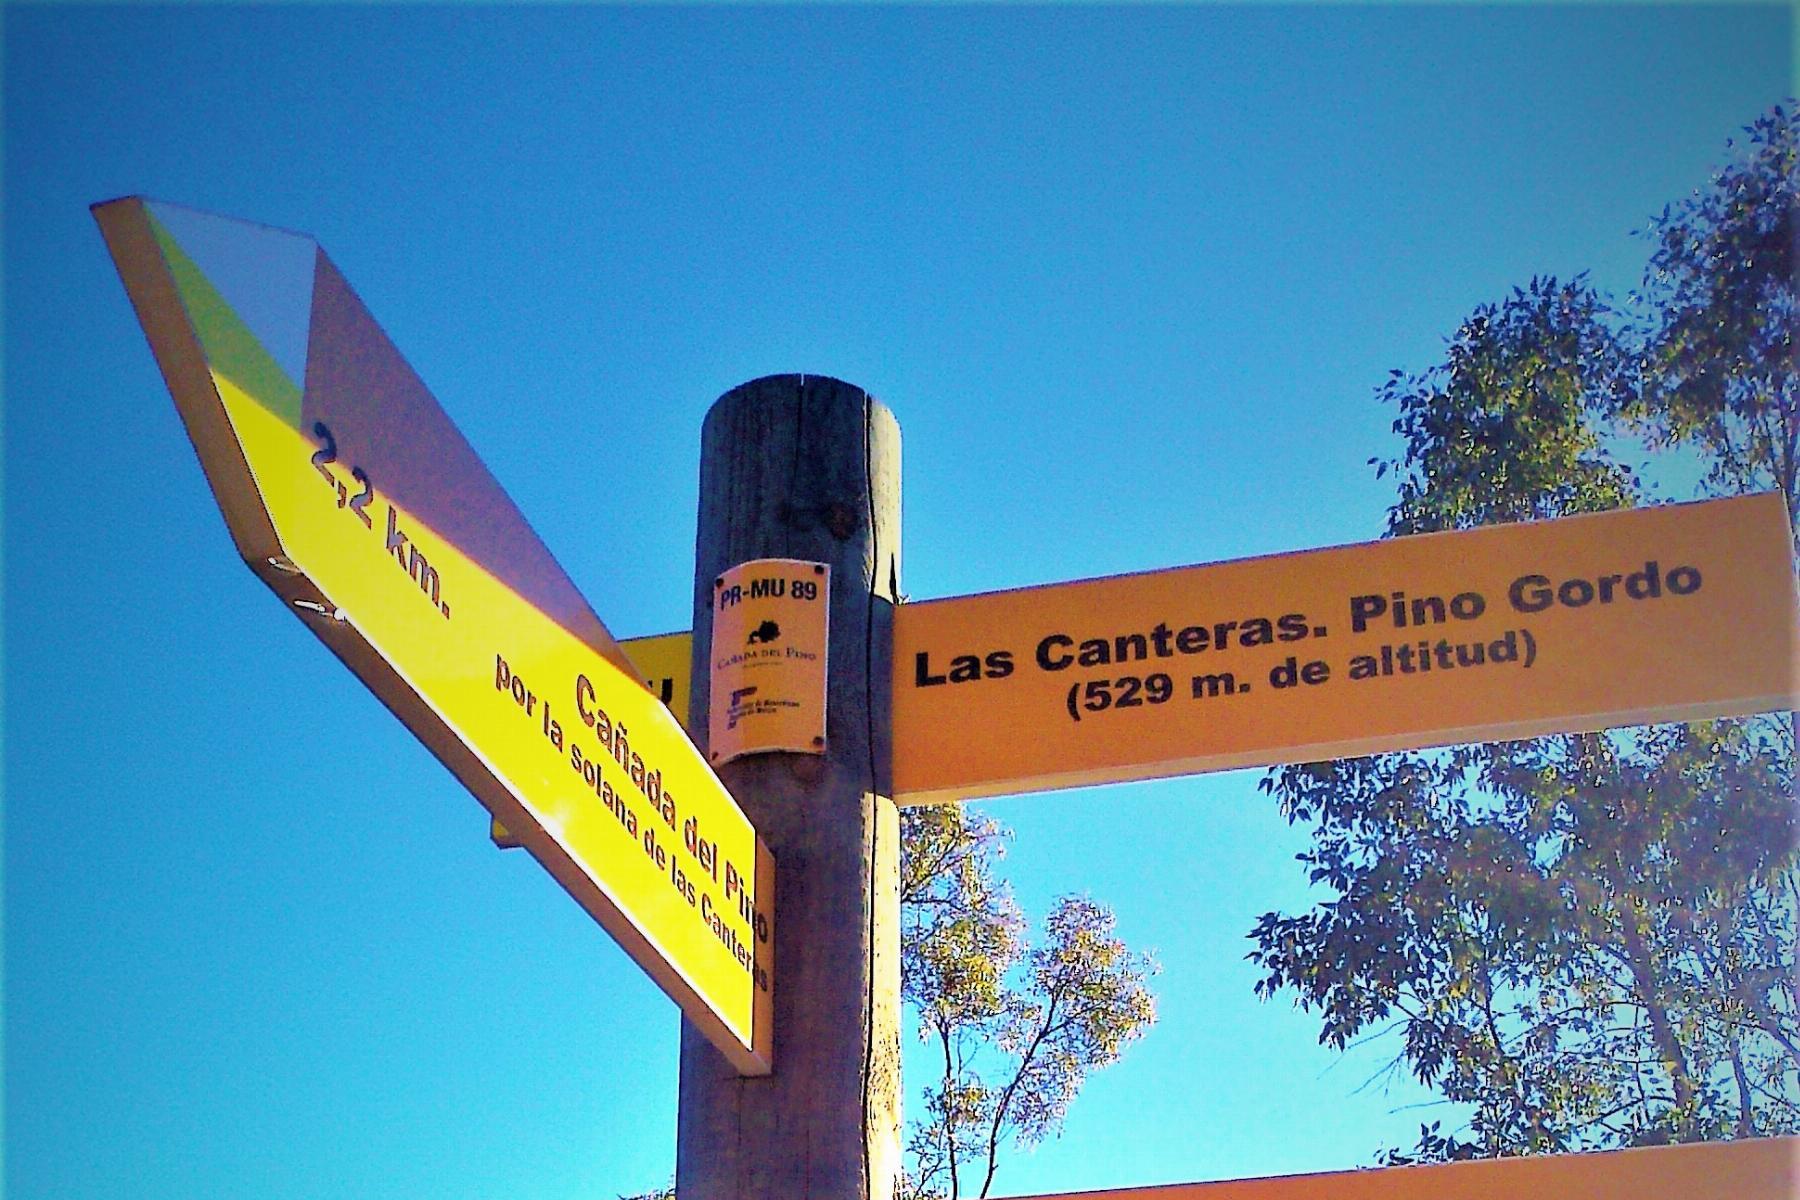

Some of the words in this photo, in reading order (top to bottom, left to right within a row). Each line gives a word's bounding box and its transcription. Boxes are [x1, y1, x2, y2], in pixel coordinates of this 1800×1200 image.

[312, 422, 373, 530] 2,2
[385, 504, 450, 620] km.
[720, 578, 785, 611] PR-MU
[791, 580, 818, 600] 89
[915, 650, 1015, 688] Las
[1035, 612, 1328, 671] Canteras.
[1350, 591, 1486, 633] Pino
[1508, 561, 1702, 613] Gordo
[1067, 672, 1174, 721] (529
[1191, 670, 1251, 699] m.
[1269, 656, 1331, 689] de
[1348, 628, 1537, 681] altitud)
[495, 653, 537, 717] por
[543, 701, 563, 753] la
[570, 743, 638, 840] solana
[644, 827, 666, 871] de
[671, 854, 696, 908] las
[576, 674, 676, 832] Cañada
[684, 815, 718, 884] del
